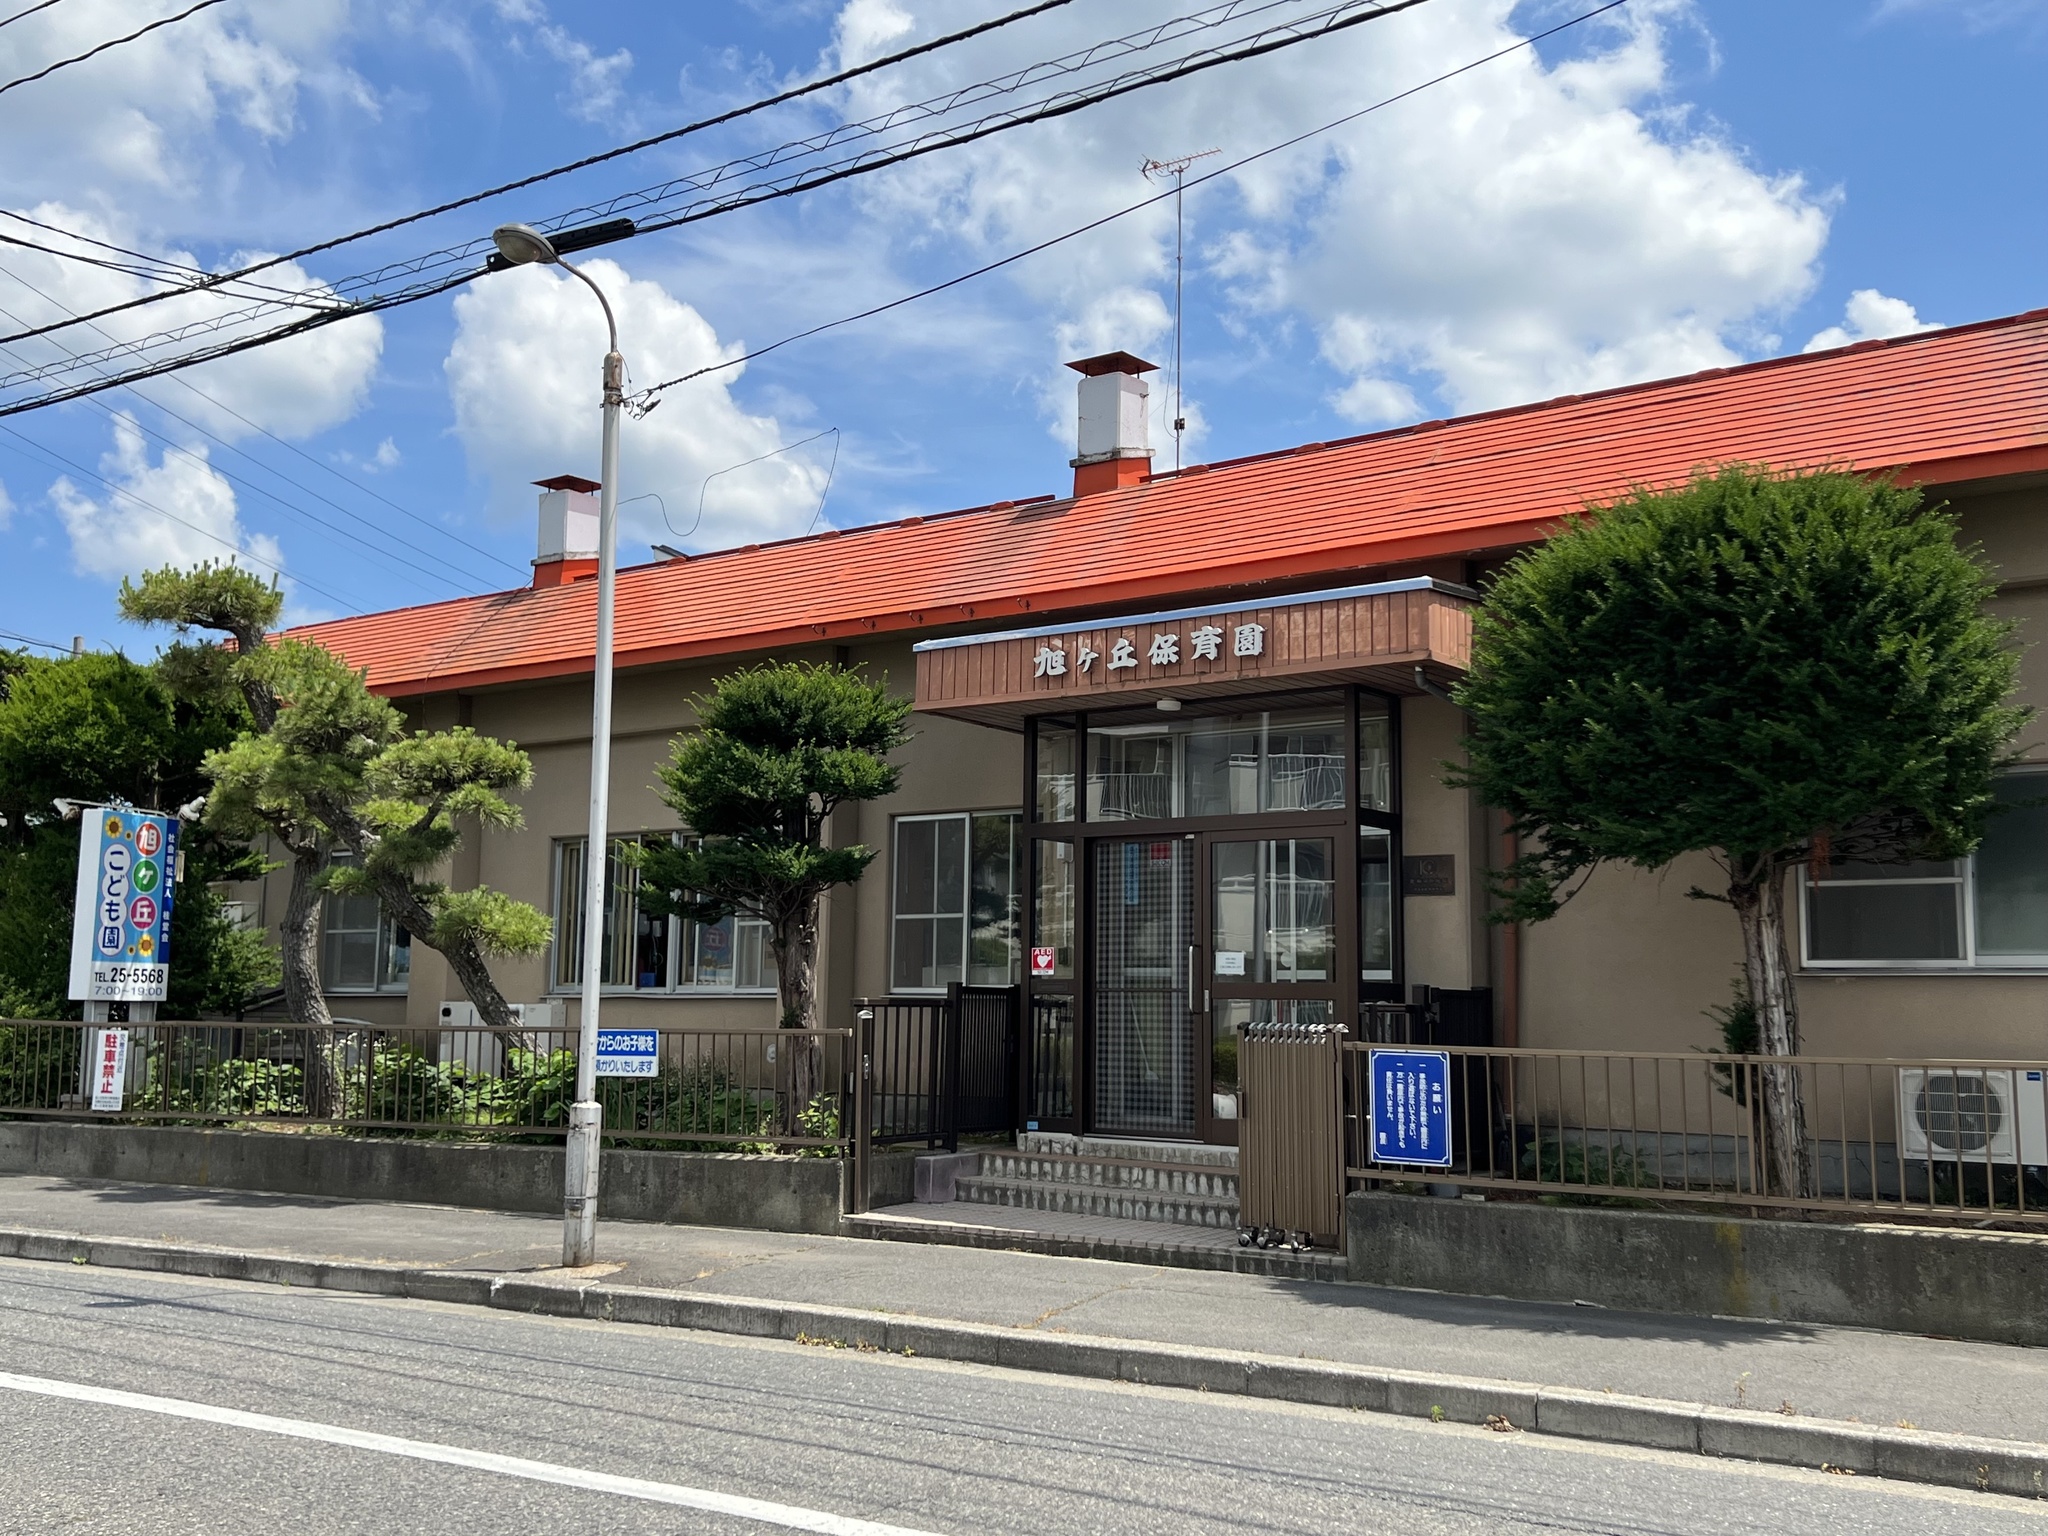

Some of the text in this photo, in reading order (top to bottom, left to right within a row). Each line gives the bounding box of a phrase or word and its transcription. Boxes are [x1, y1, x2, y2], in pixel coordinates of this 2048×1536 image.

[103, 851, 125, 949] こども園
[1034, 948, 1052, 956] AED
[110, 967, 164, 984] 25-5568
[597, 1035, 654, 1051] からのお子様を
[100, 1033, 118, 1094] 駐車禁止
